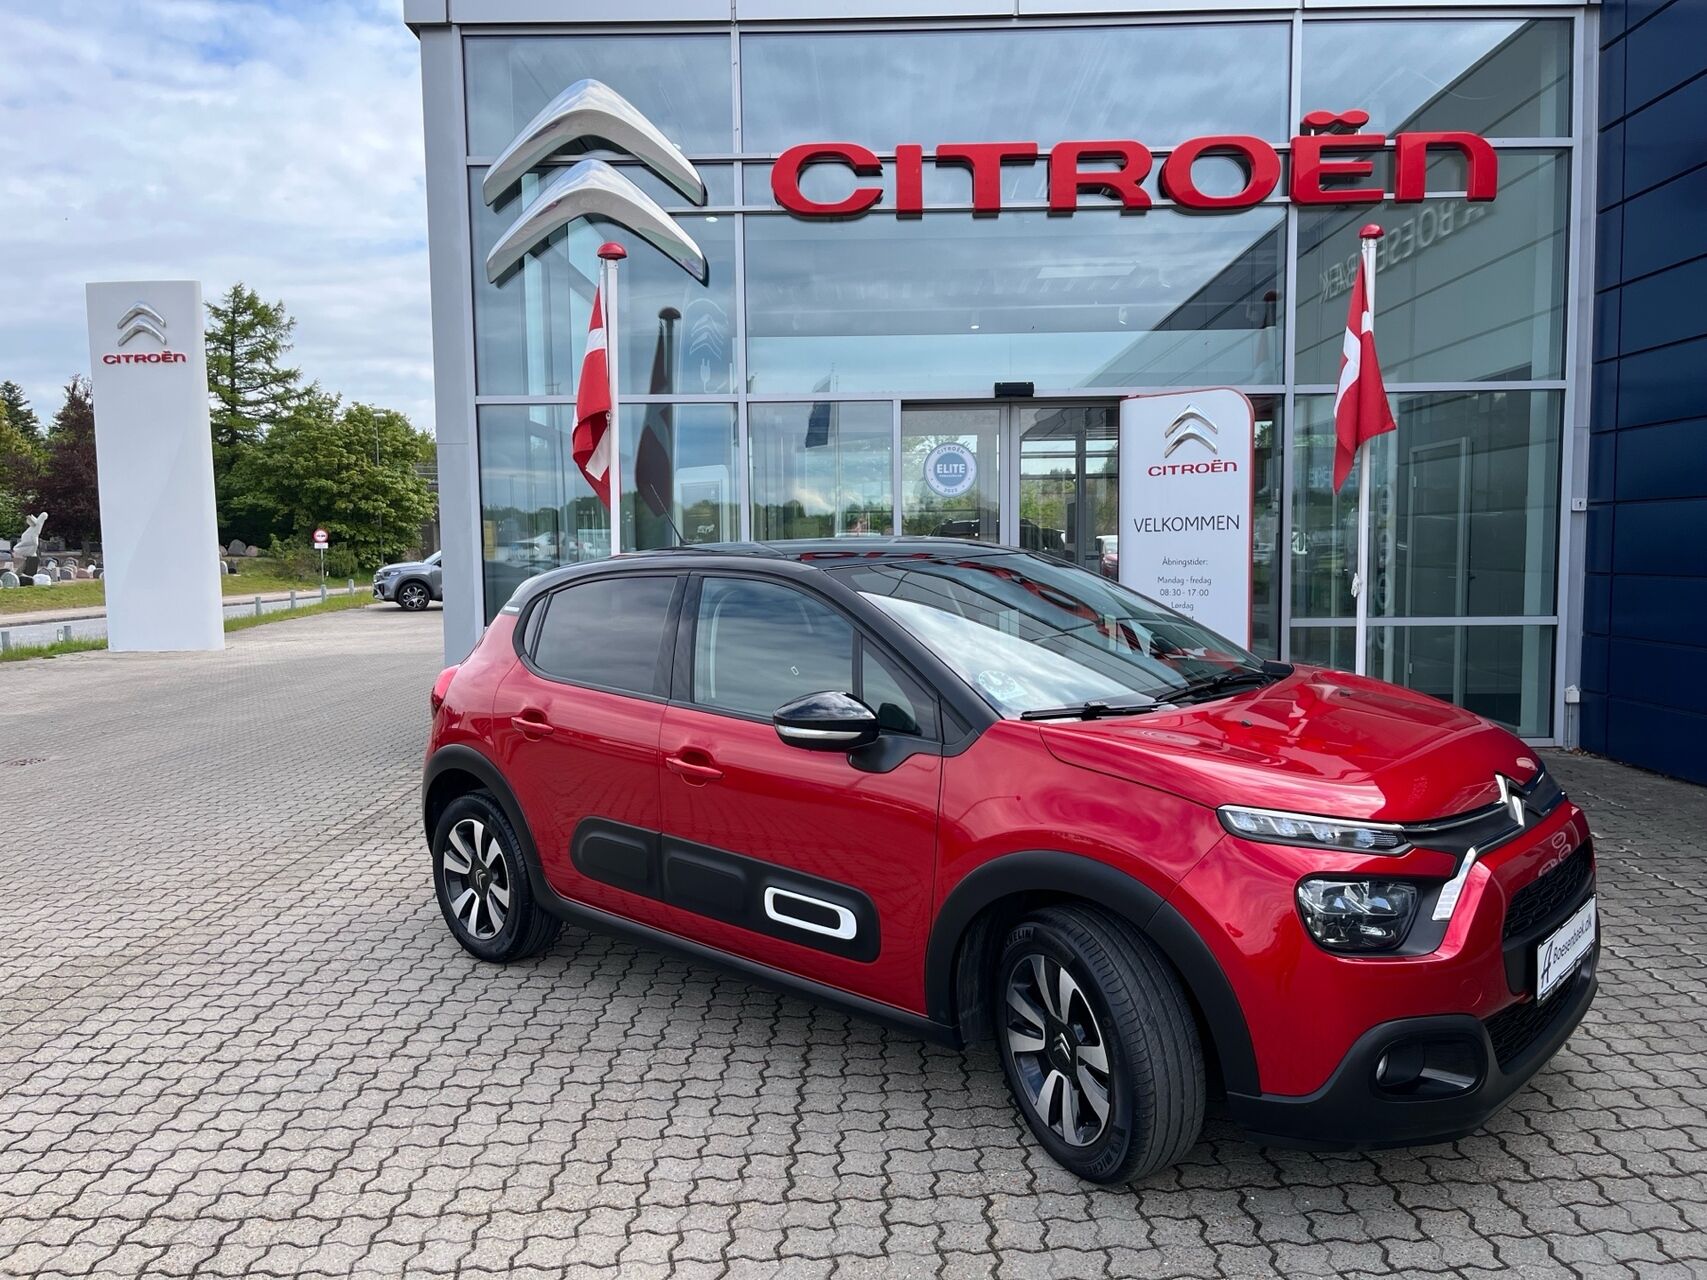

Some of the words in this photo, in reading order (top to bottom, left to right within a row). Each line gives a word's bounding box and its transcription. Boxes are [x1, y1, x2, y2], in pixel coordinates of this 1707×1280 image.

[937, 463, 965, 474] ELITE
[1133, 514, 1240, 533] VELKOMMEN
[1161, 555, 1209, 567] Åbningstider:
[1157, 576, 1185, 586] Mandag
[1190, 575, 1212, 585] fredag
